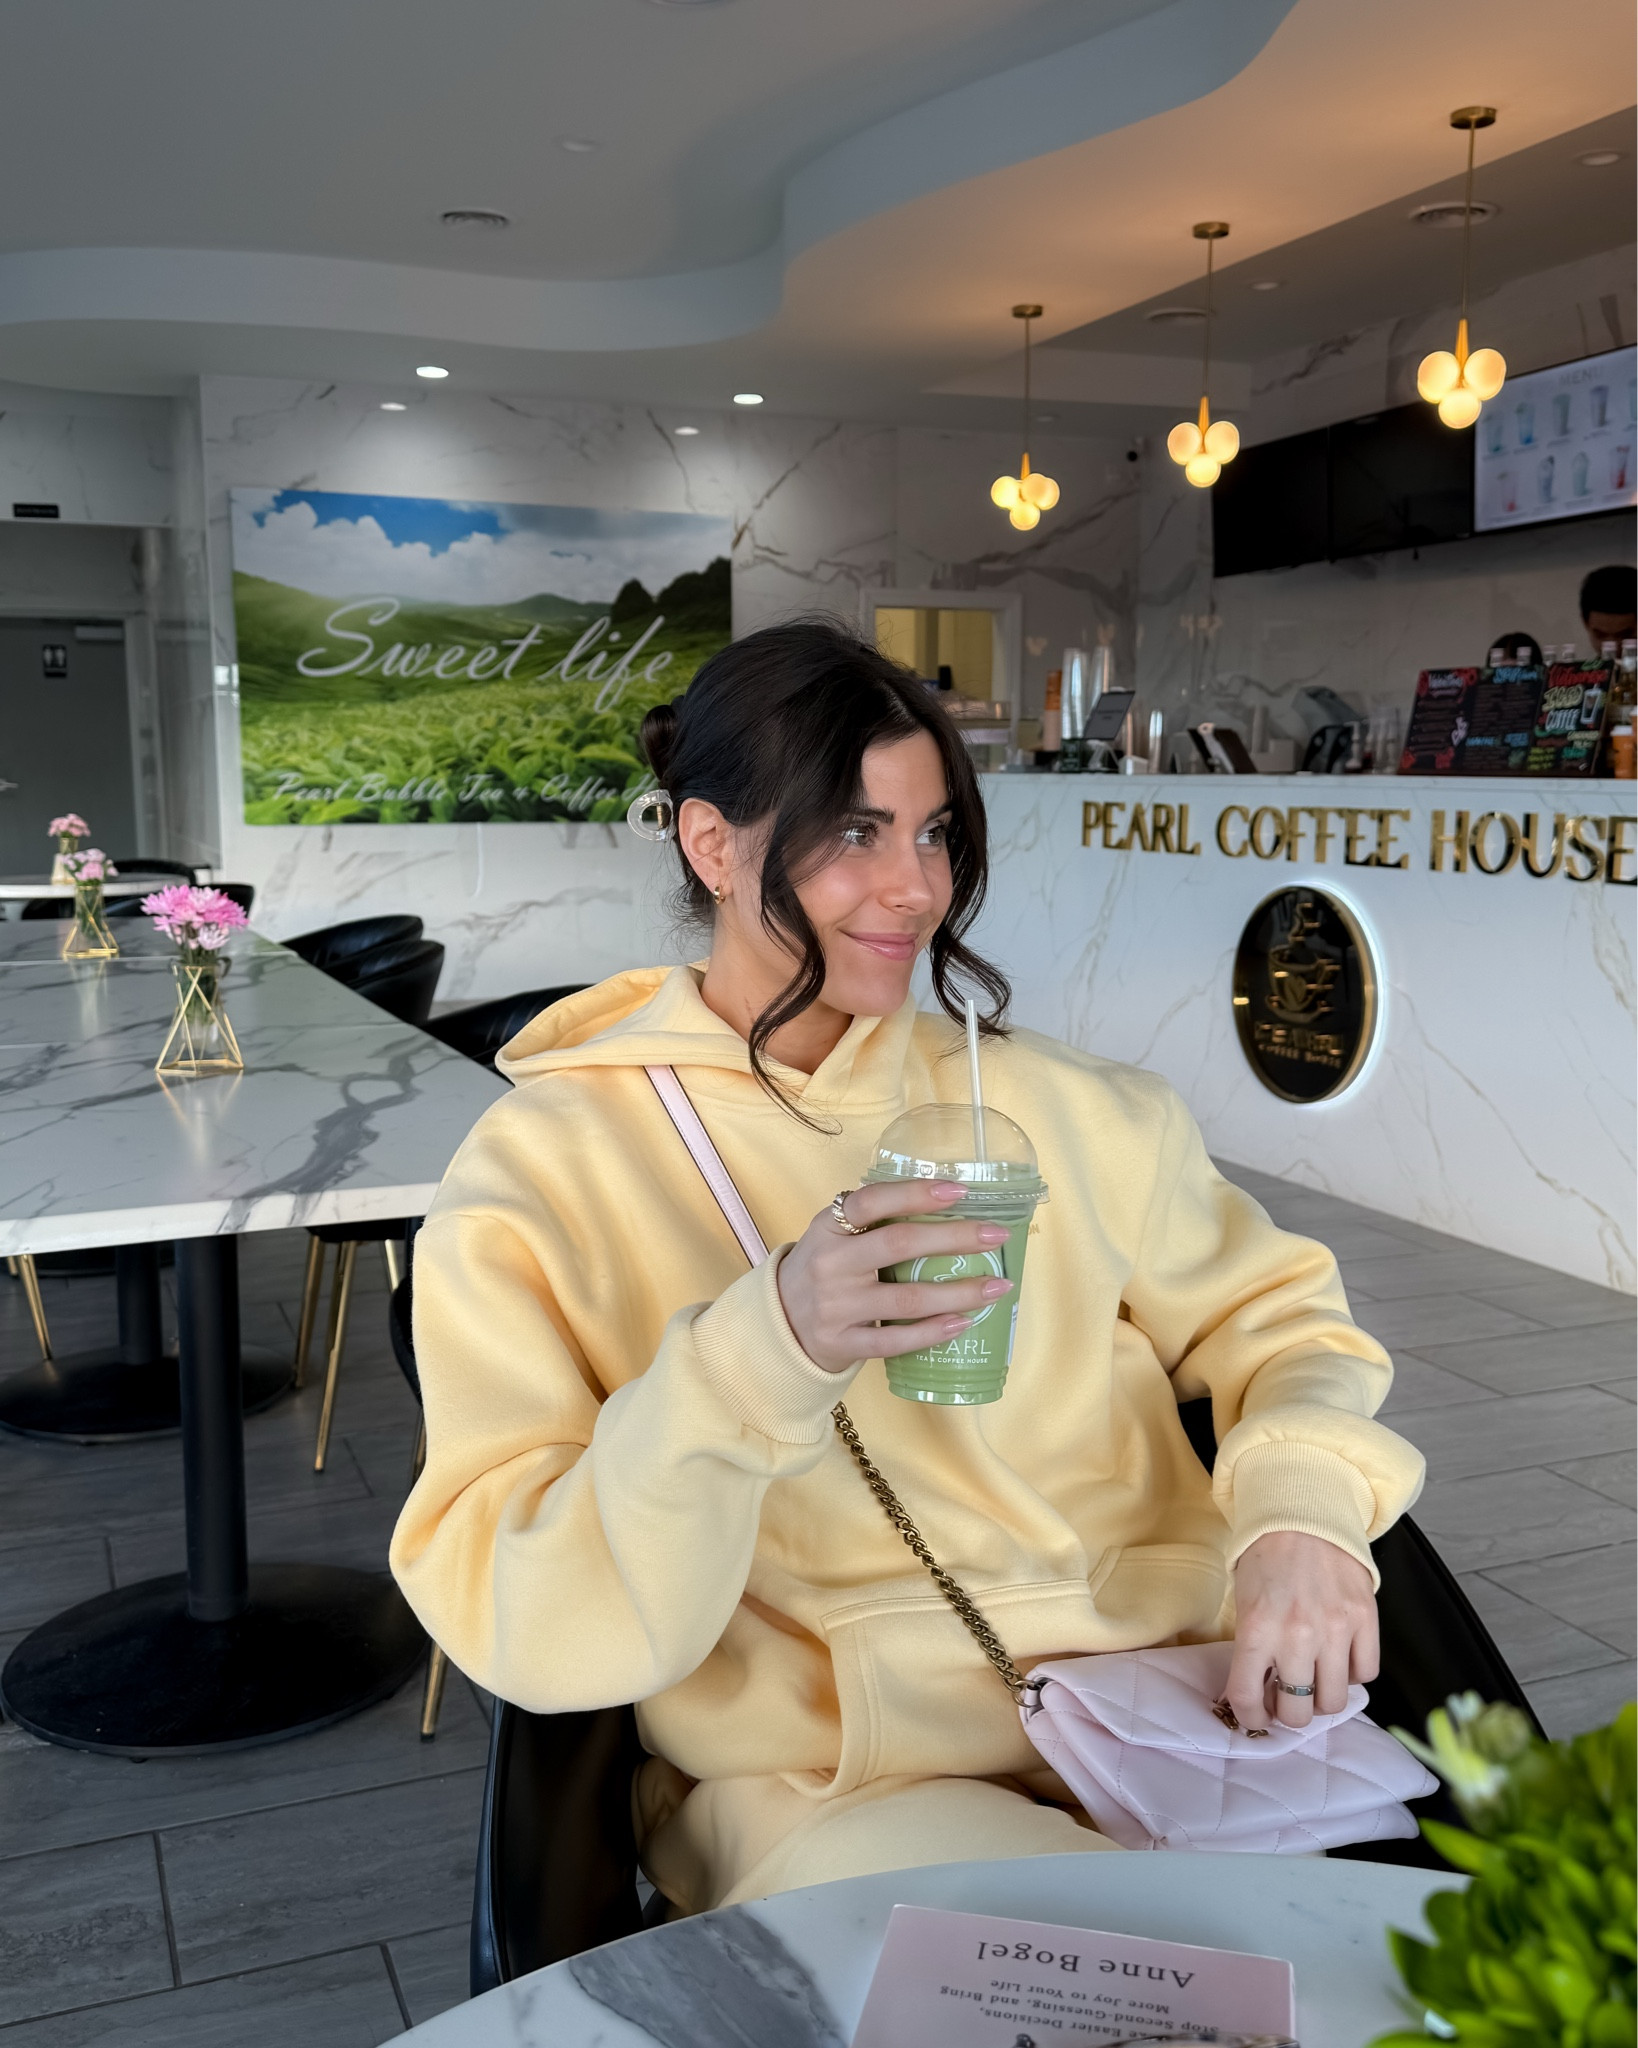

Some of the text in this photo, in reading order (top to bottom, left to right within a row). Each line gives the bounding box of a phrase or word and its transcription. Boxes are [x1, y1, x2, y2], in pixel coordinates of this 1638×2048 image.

[296, 596, 673, 714] Sweet life
[1545, 709, 1580, 732] COFFEE
[273, 772, 352, 801] Pearl
[354, 772, 447, 803] Bubble
[458, 773, 505, 803] Tea
[541, 773, 618, 812] Coffee
[1081, 800, 1637, 886] PEARL COFFEE HOUSE
[929, 1339, 992, 1355] EARL
[977, 1941, 1196, 1989] Anne Bogel
[940, 1985, 983, 2002] Bring
[990, 1979, 1170, 2014] More Joy to Your Life
[990, 1994, 1020, 2005] and
[979, 2007, 1063, 2029] Decisions,
[1181, 2021, 1219, 2033] Stop
[1070, 2021, 1121, 2038] Easier
